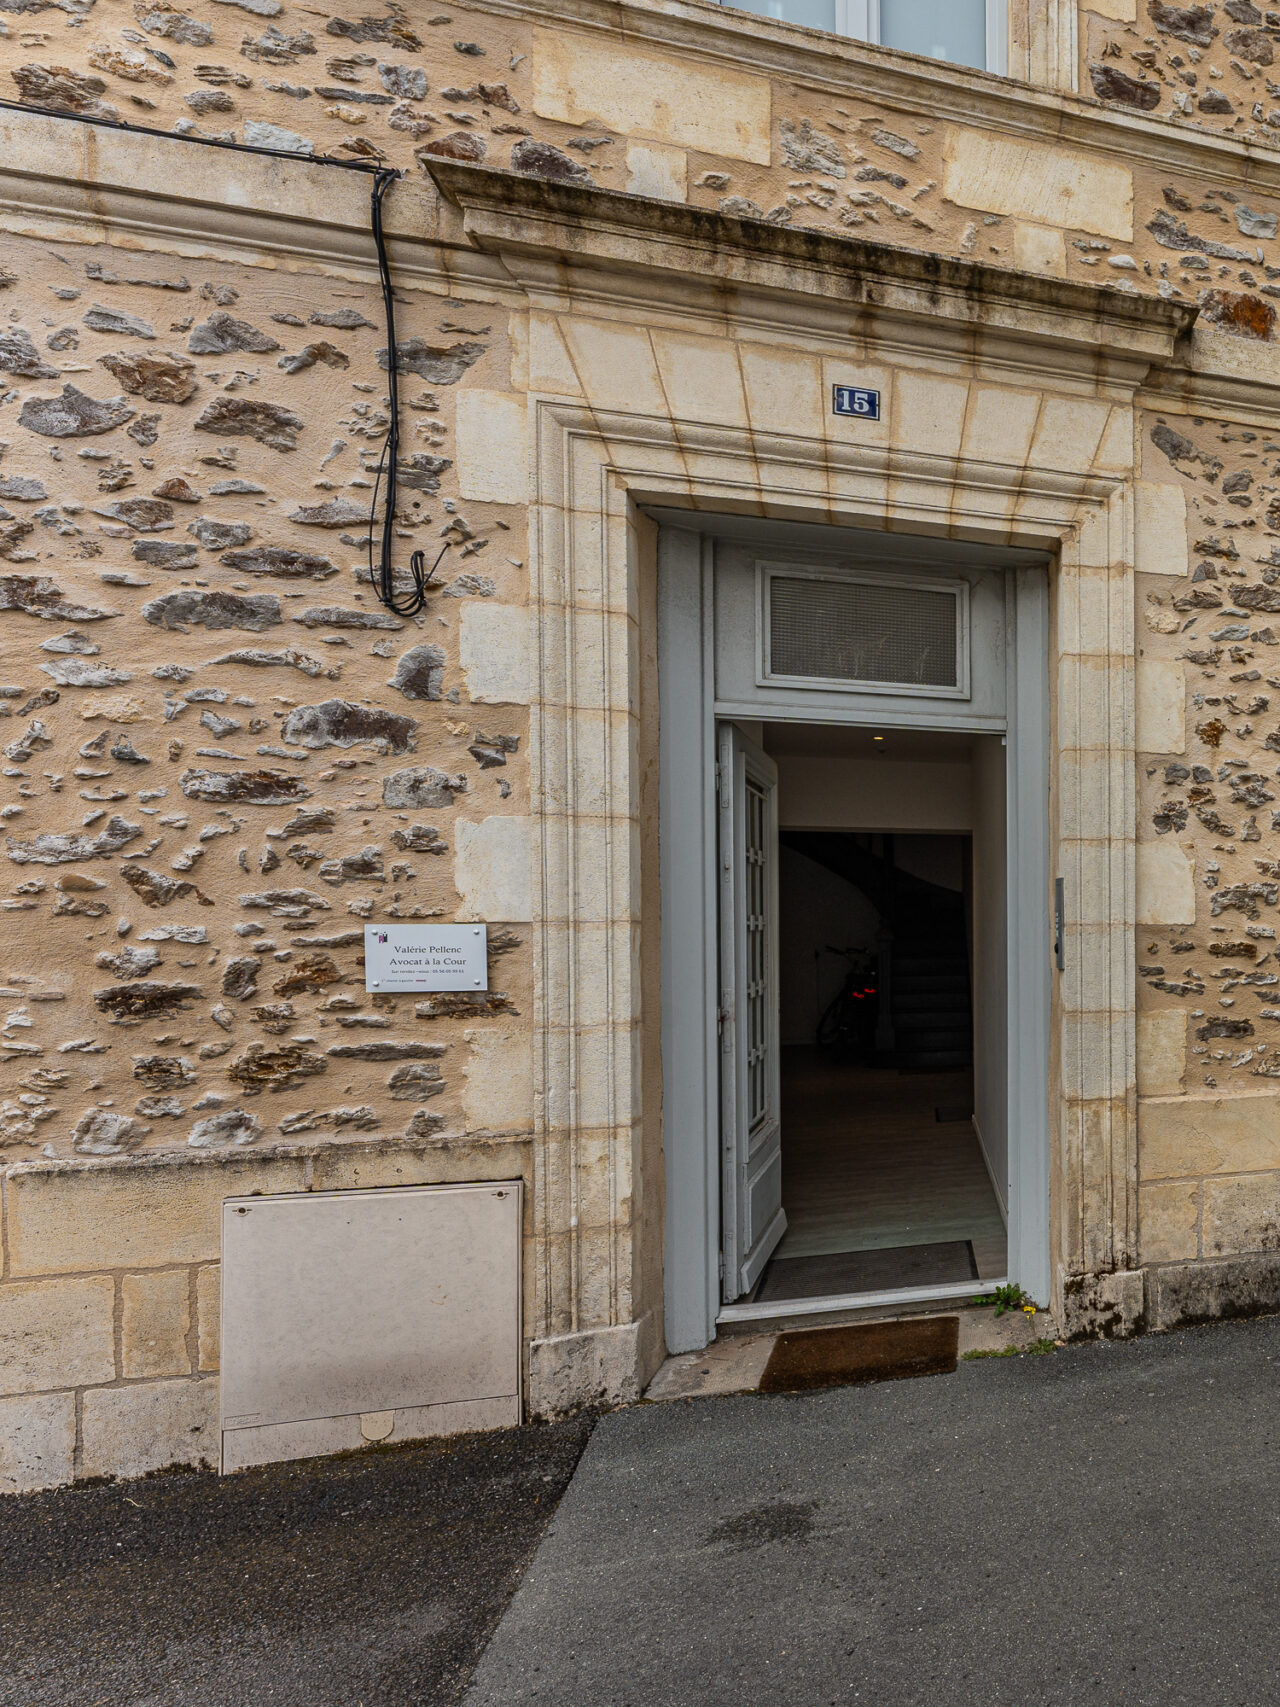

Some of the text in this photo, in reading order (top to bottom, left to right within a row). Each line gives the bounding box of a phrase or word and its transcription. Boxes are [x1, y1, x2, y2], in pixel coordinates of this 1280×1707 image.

[841, 390, 870, 412] 15
[394, 945, 462, 953] Valérie Pellenc
[424, 957, 430, 965] à
[432, 957, 441, 965] la
[443, 957, 467, 965] Cour
